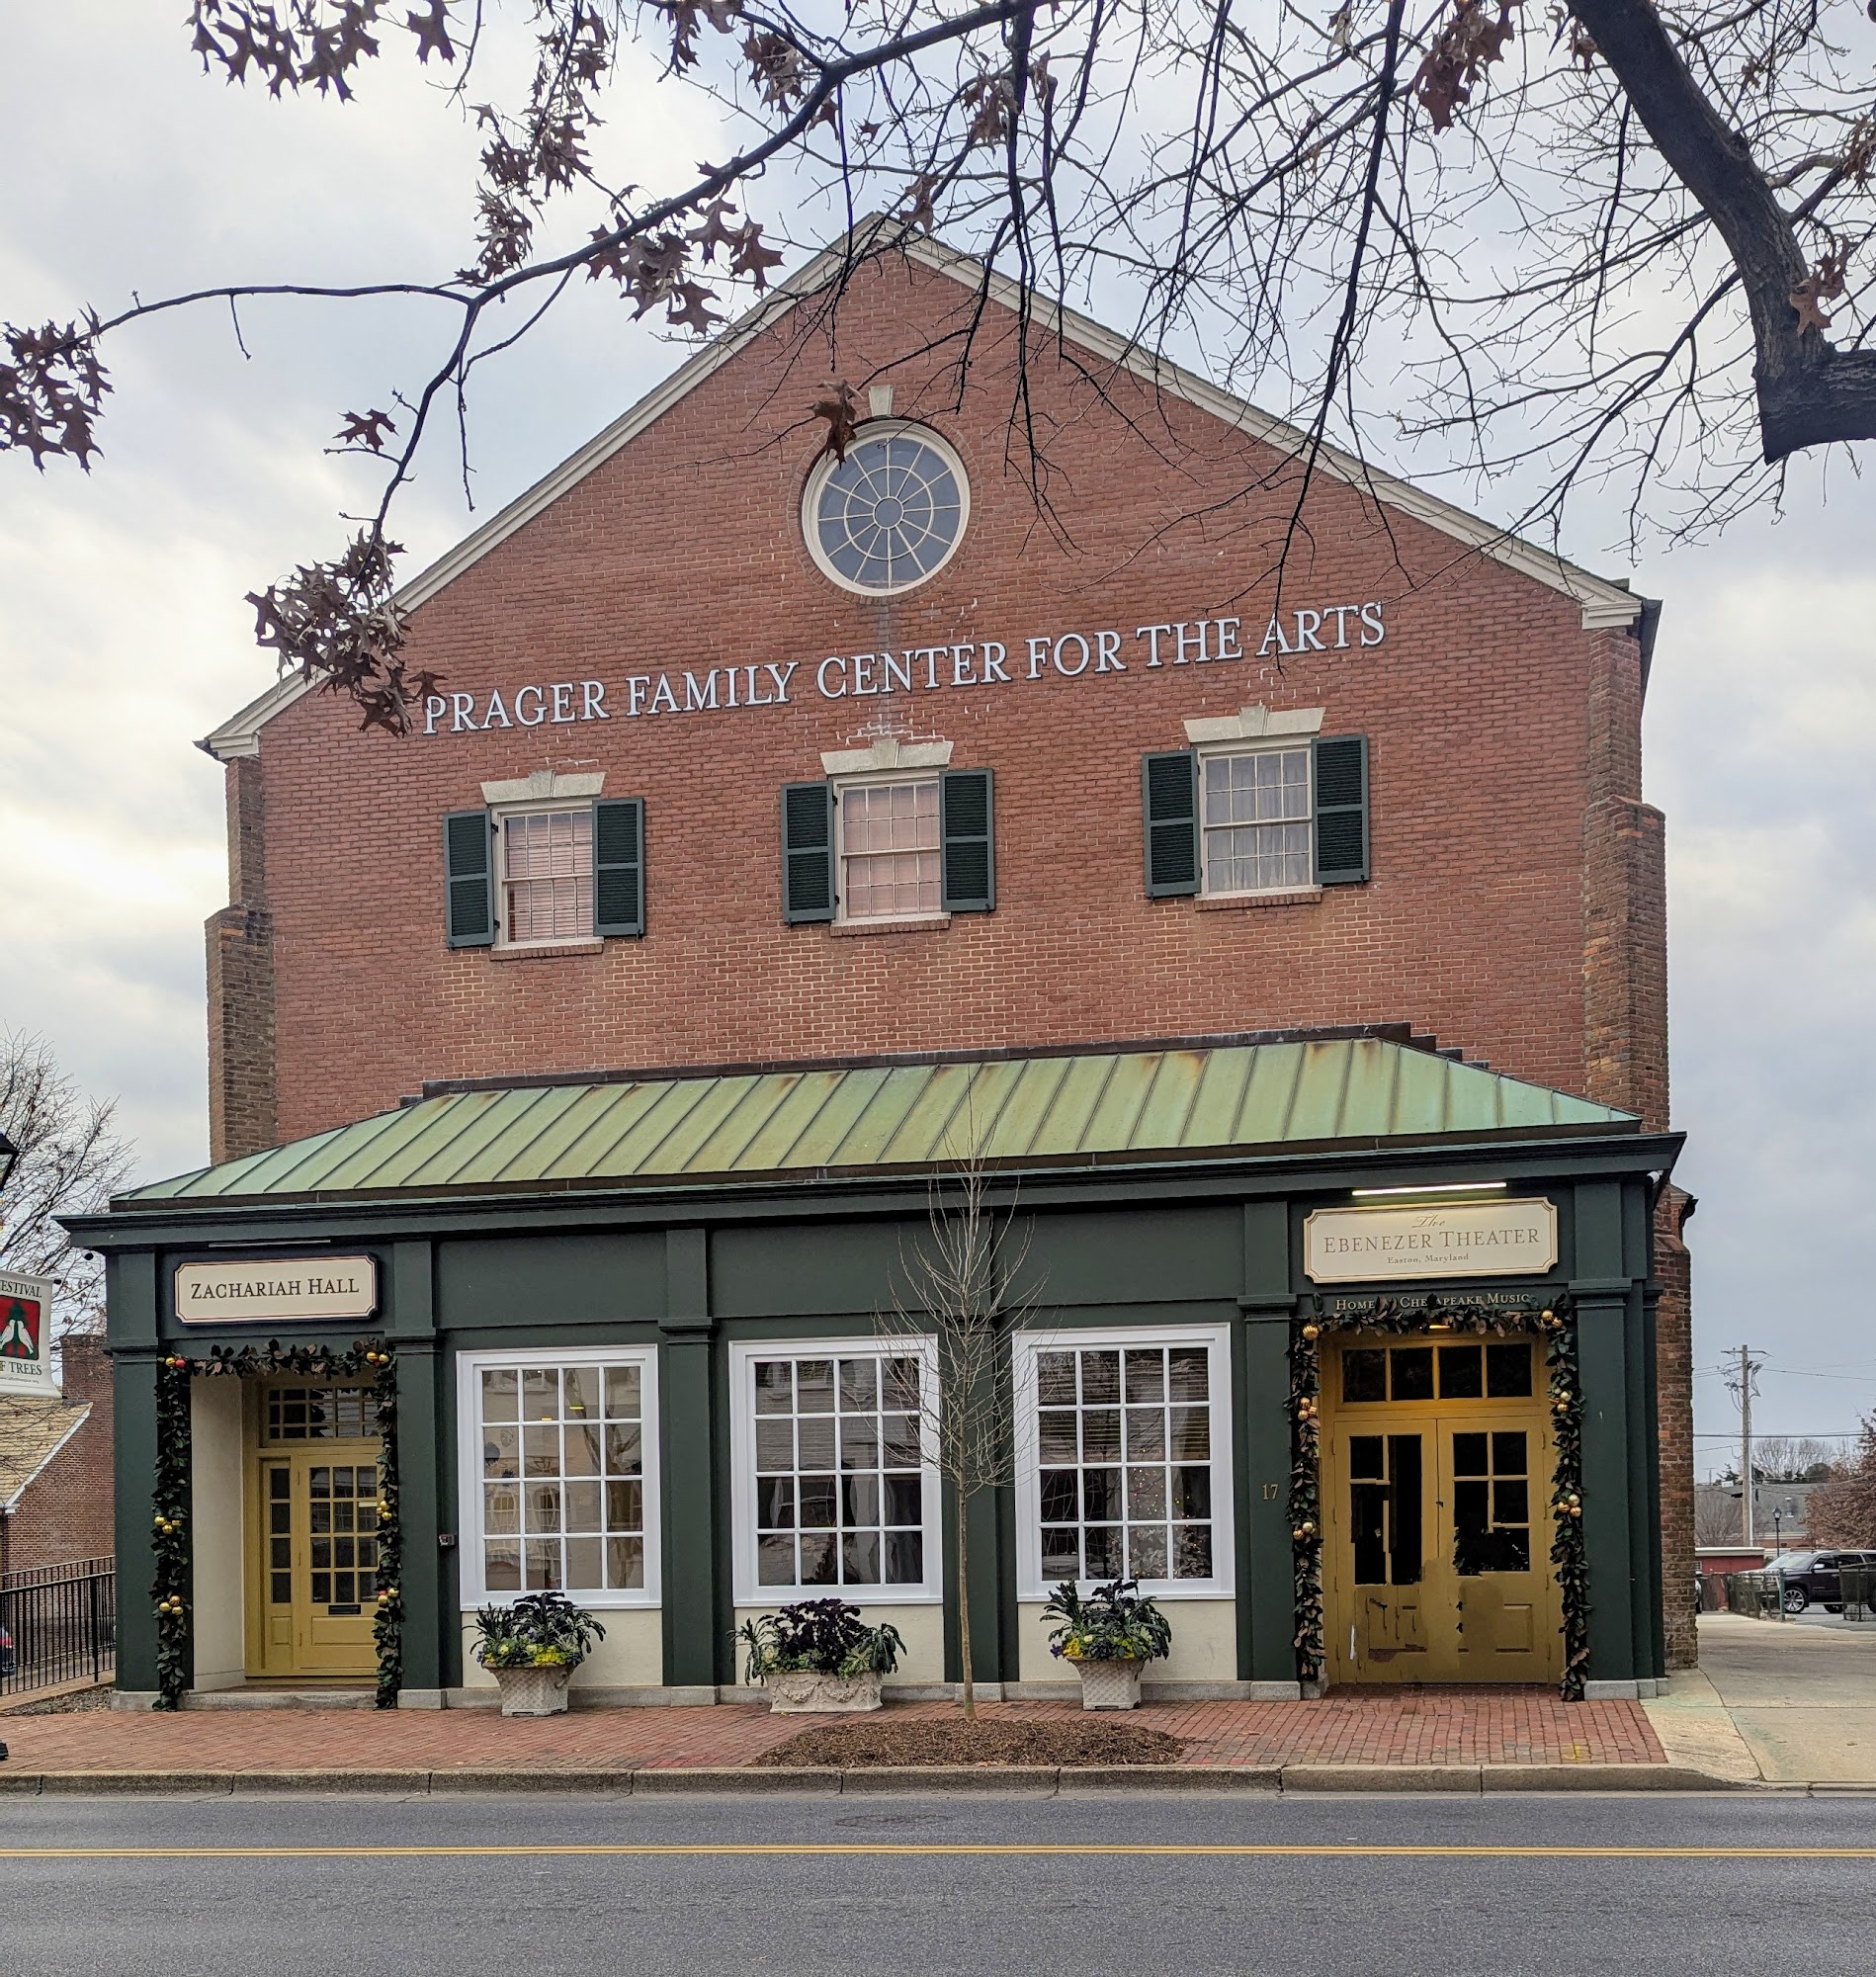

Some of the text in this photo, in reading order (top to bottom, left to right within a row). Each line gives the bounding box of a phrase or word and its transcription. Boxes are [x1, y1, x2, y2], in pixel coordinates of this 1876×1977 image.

[422, 601, 1385, 734] PRAGER FAMILY CENTER FOR THE ARTS
[1411, 1213, 1446, 1229] The
[1323, 1228, 1540, 1253] EBENEZER THEATER
[1387, 1252, 1469, 1265] Easton, Maryland
[0, 1279, 43, 1298] ESTIVAL
[191, 1278, 360, 1300] ZACHARIAH HALL
[1335, 1293, 1530, 1311] HOME CHEAPEAKE MUSIC
[9, 1361, 43, 1375] TREES
[1262, 1483, 1279, 1501] 17
